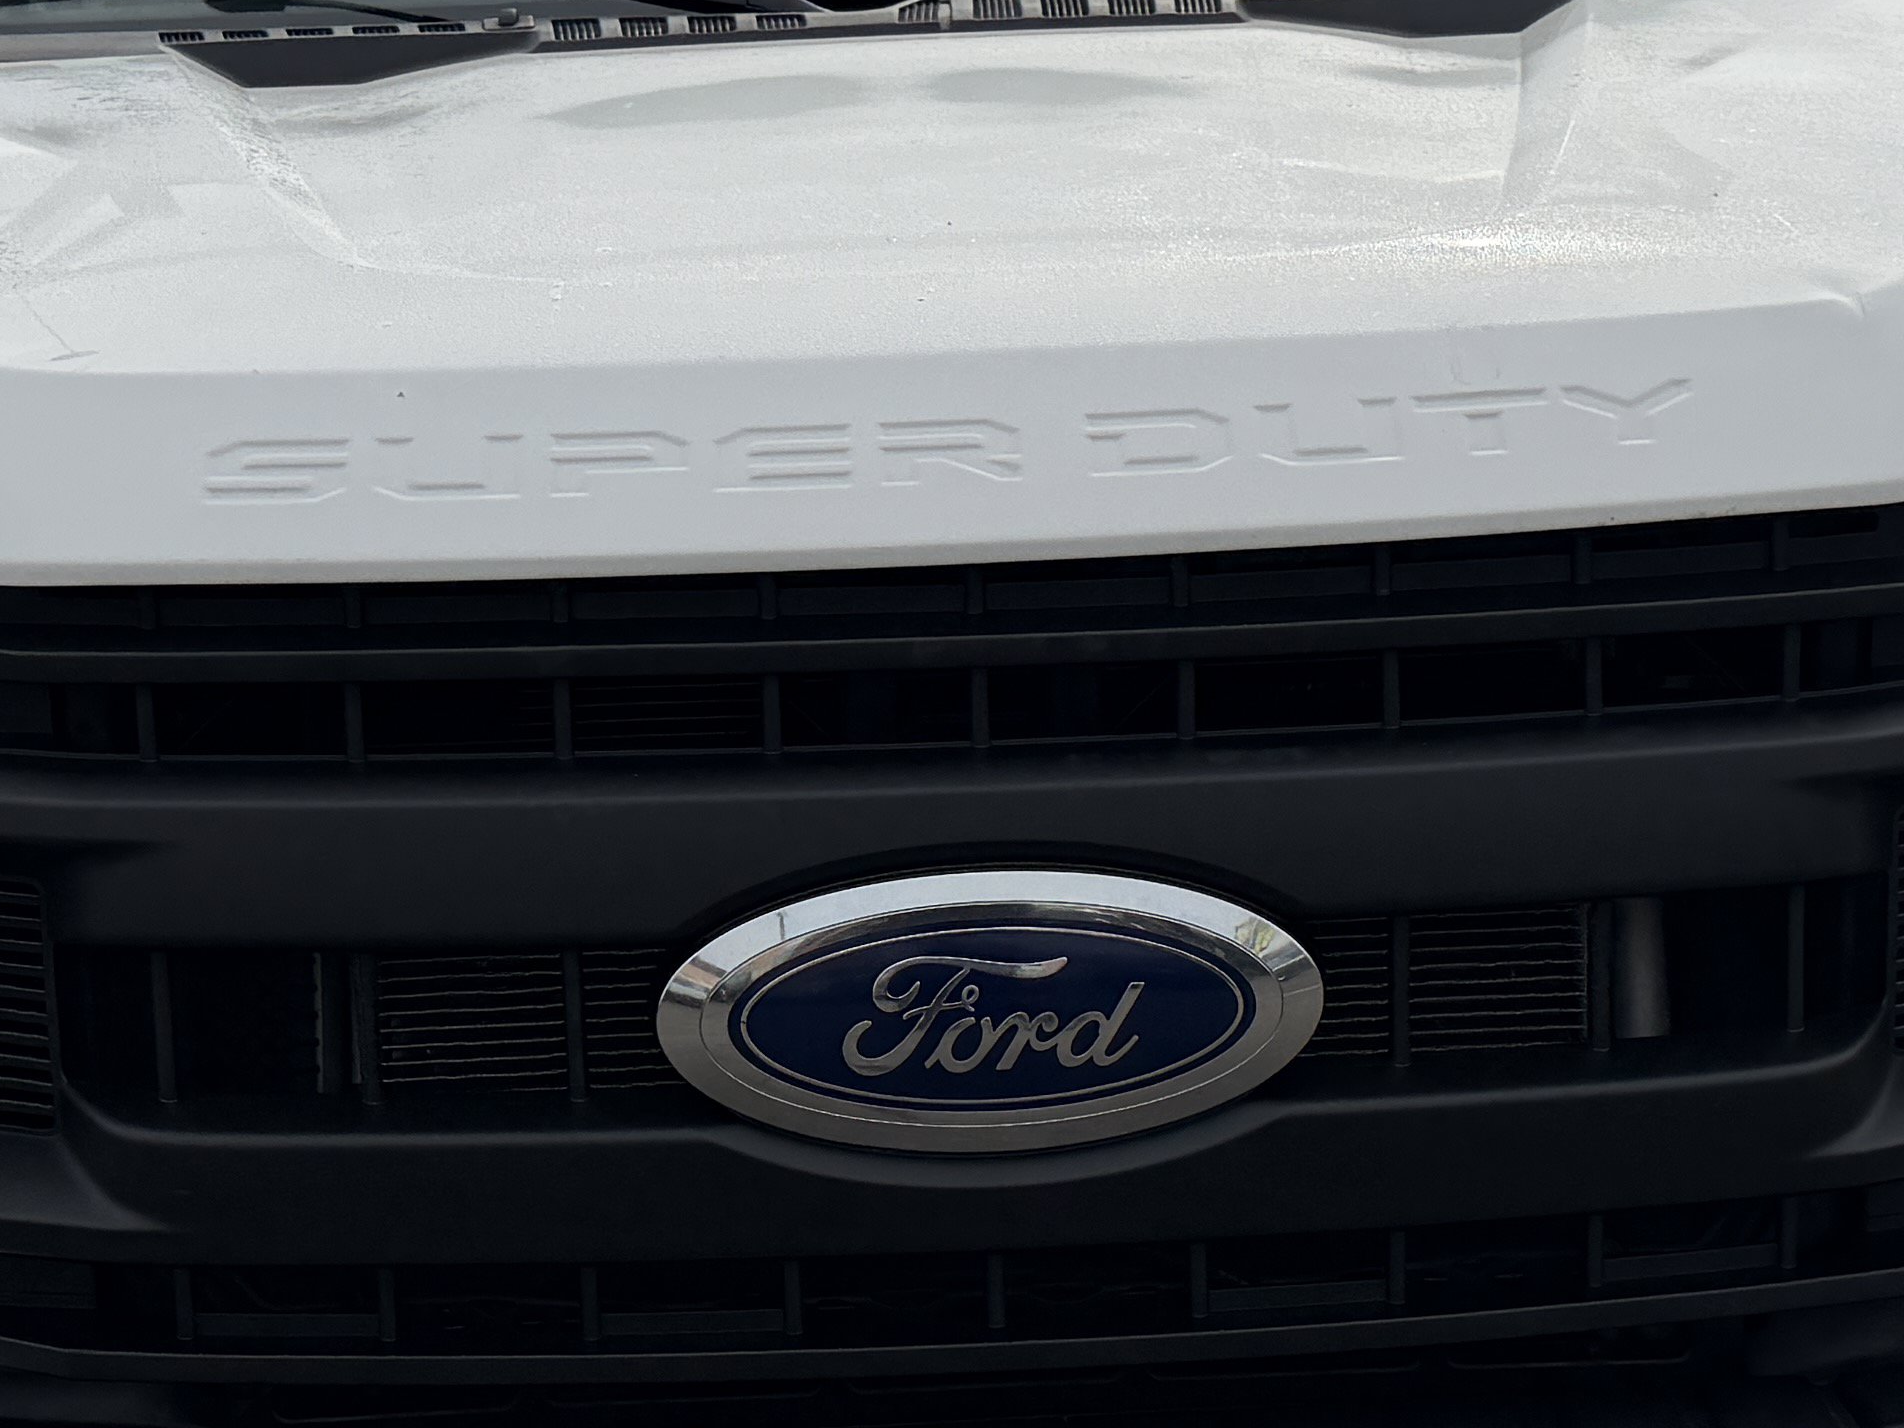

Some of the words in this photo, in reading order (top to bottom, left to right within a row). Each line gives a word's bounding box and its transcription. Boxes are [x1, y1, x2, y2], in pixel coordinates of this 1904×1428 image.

[202, 415, 1021, 505] SUPER
[1083, 377, 1695, 479] DUTY
[842, 954, 1146, 1077] Ford
